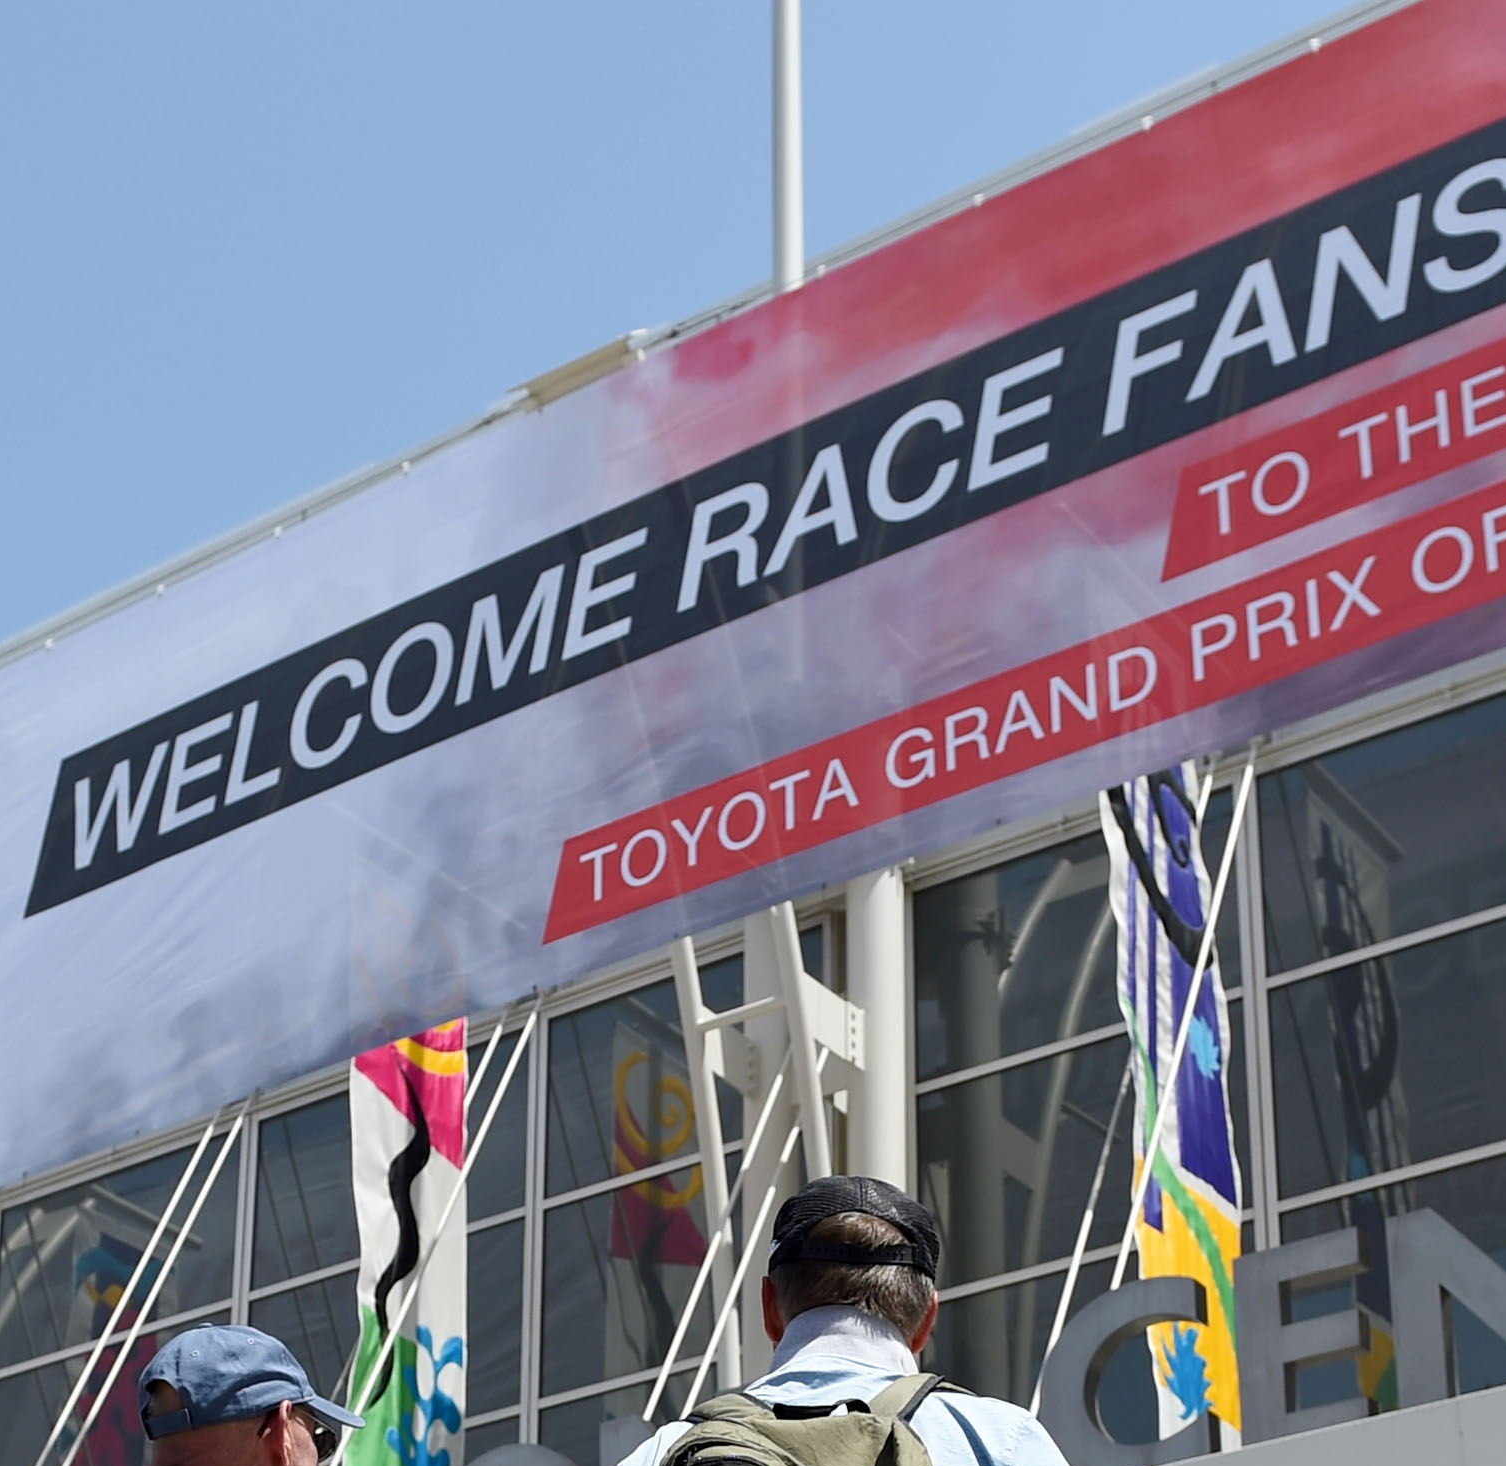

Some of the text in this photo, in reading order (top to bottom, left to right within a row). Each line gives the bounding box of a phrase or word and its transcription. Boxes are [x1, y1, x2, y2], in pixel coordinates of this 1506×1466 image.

[74, 527, 648, 870] WELCOME
[676, 346, 1064, 613] RACE
[1198, 451, 1310, 535] TO
[578, 757, 860, 902] TOYOTA
[884, 645, 1158, 789] GRAND
[1190, 555, 1381, 682] PRIX
